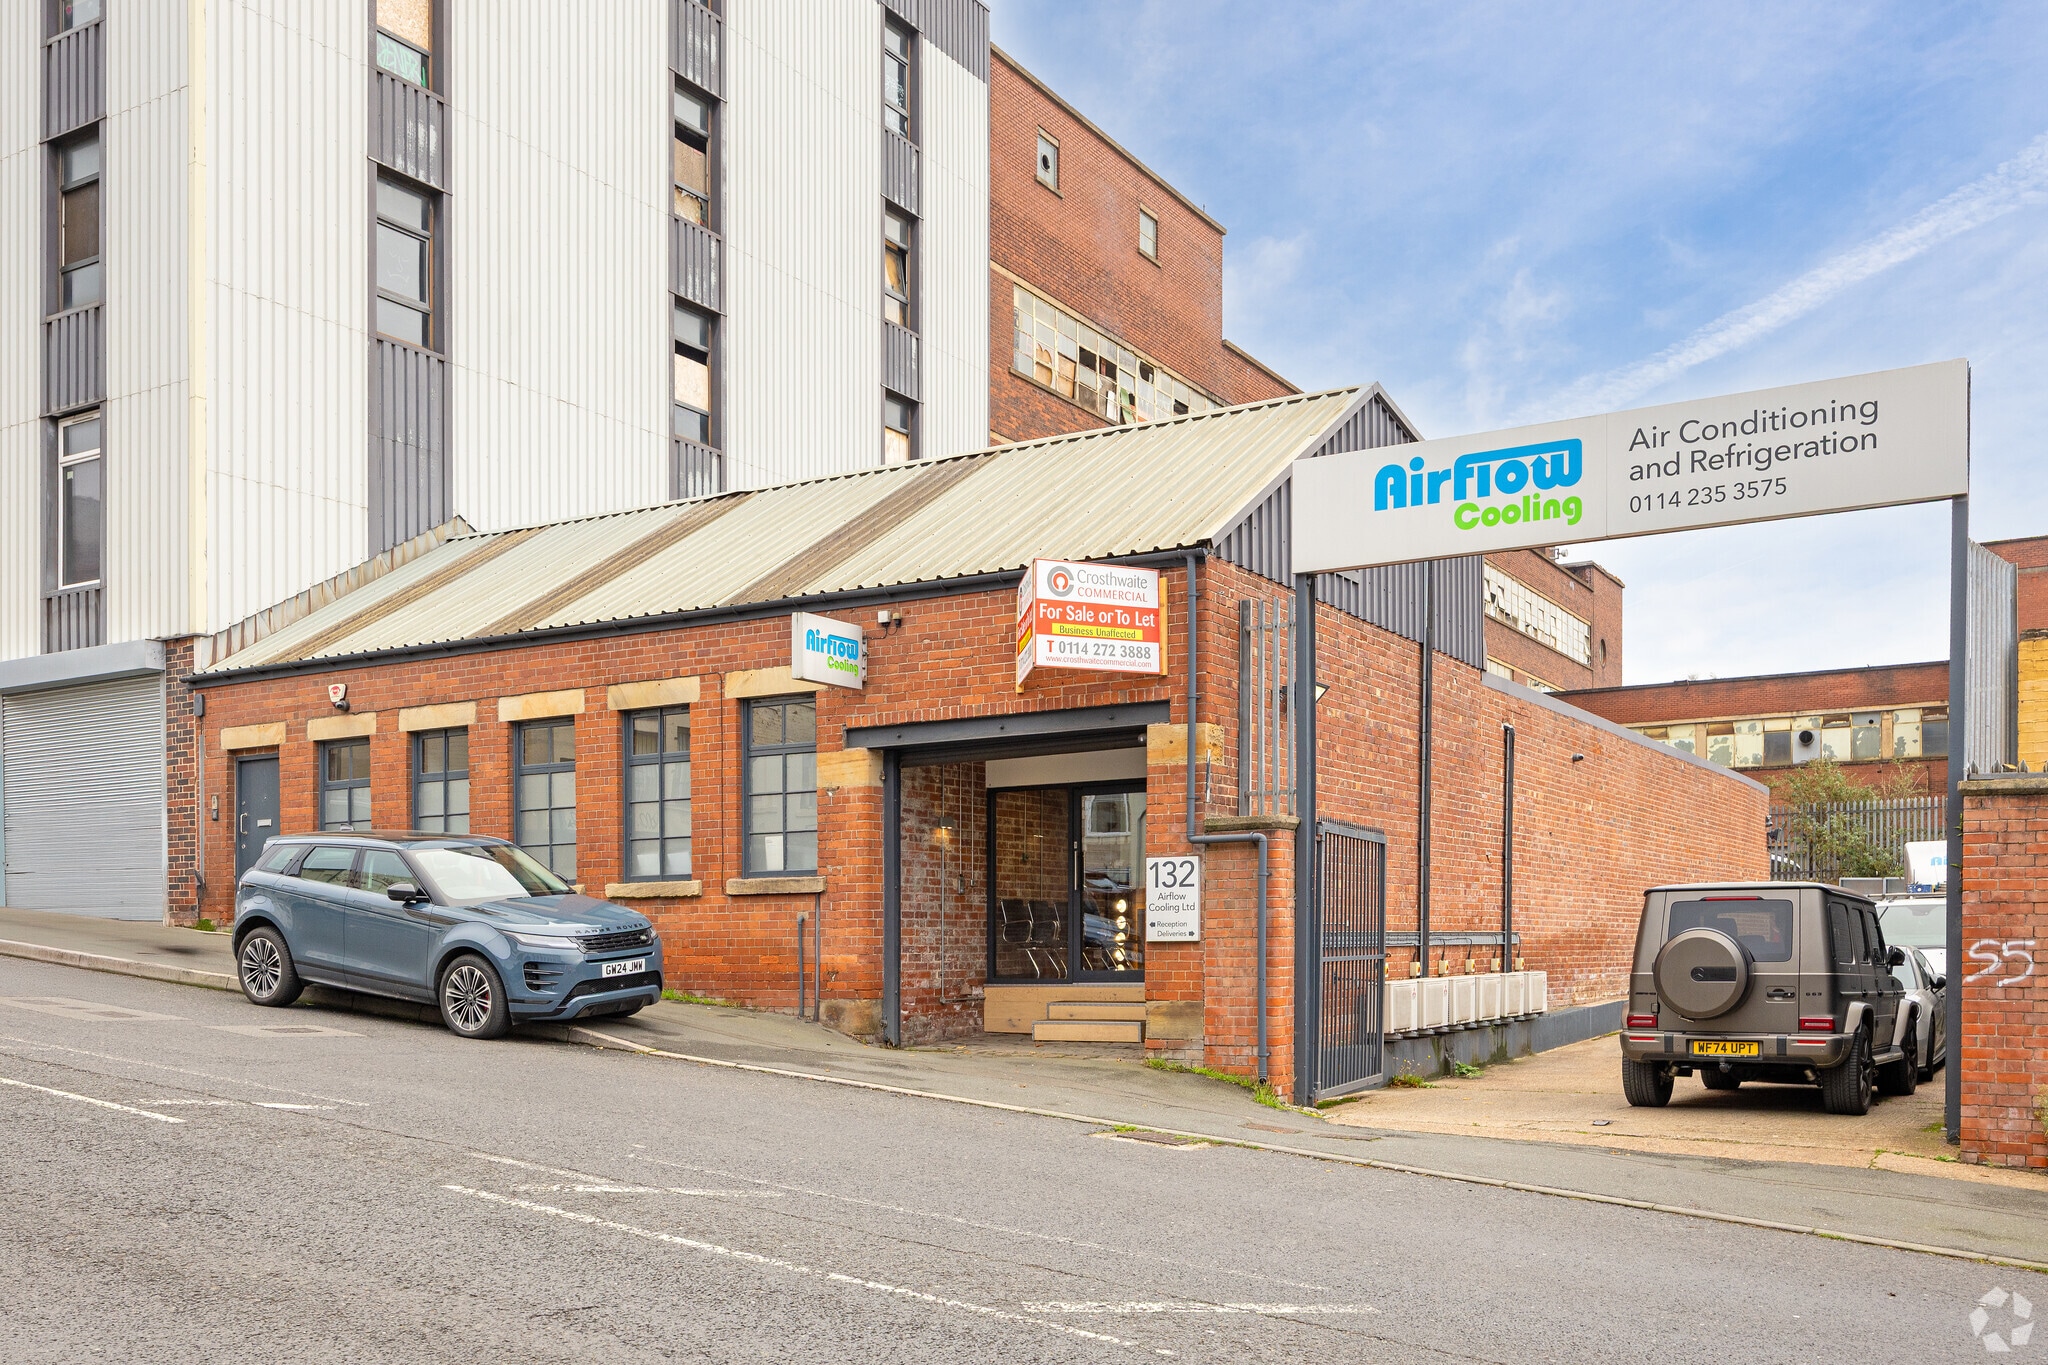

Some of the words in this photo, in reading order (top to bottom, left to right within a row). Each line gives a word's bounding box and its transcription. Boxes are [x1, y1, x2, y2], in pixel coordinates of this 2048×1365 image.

[1628, 423, 1669, 452] Air
[1678, 398, 1880, 446] Conditioning
[1628, 449, 1682, 482] and
[1689, 430, 1878, 479] Refrigeration
[1373, 438, 1583, 512] Airflow
[1629, 492, 1682, 514] 0114
[1687, 485, 1728, 506] 235
[1734, 476, 1787, 501] 3575
[1453, 492, 1583, 531] Cooling
[1077, 569, 1148, 589] Crosthwaite
[1078, 588, 1148, 602] COMMERCIAL
[1039, 603, 1063, 620] For
[1065, 606, 1095, 623] Sale
[1098, 612, 1114, 624] or
[1114, 610, 1130, 625] To
[1135, 612, 1155, 627] Let
[1059, 625, 1093, 636] Business
[1096, 627, 1136, 639] Unaffected
[806, 629, 858, 660] Airflow
[1046, 640, 1054, 653] T
[1059, 641, 1088, 656] 0114
[1093, 643, 1116, 657] 272
[1120, 645, 1151, 659] 3888
[827, 656, 858, 677] Cooling
[1045, 655, 1152, 668] www.crosthwaitecommercial.com
[1149, 860, 1195, 888] 132
[1157, 892, 1187, 901] Airflow
[1148, 903, 1180, 913] Cooling
[1182, 903, 1196, 911] Ltd
[616, 922, 643, 930] ROVER
[1156, 921, 1188, 929] Reception
[605, 963, 626, 975] GW24
[629, 961, 643, 972] JMW
[1698, 1042, 1728, 1053] WF74
[1731, 1043, 1754, 1054] UPT
